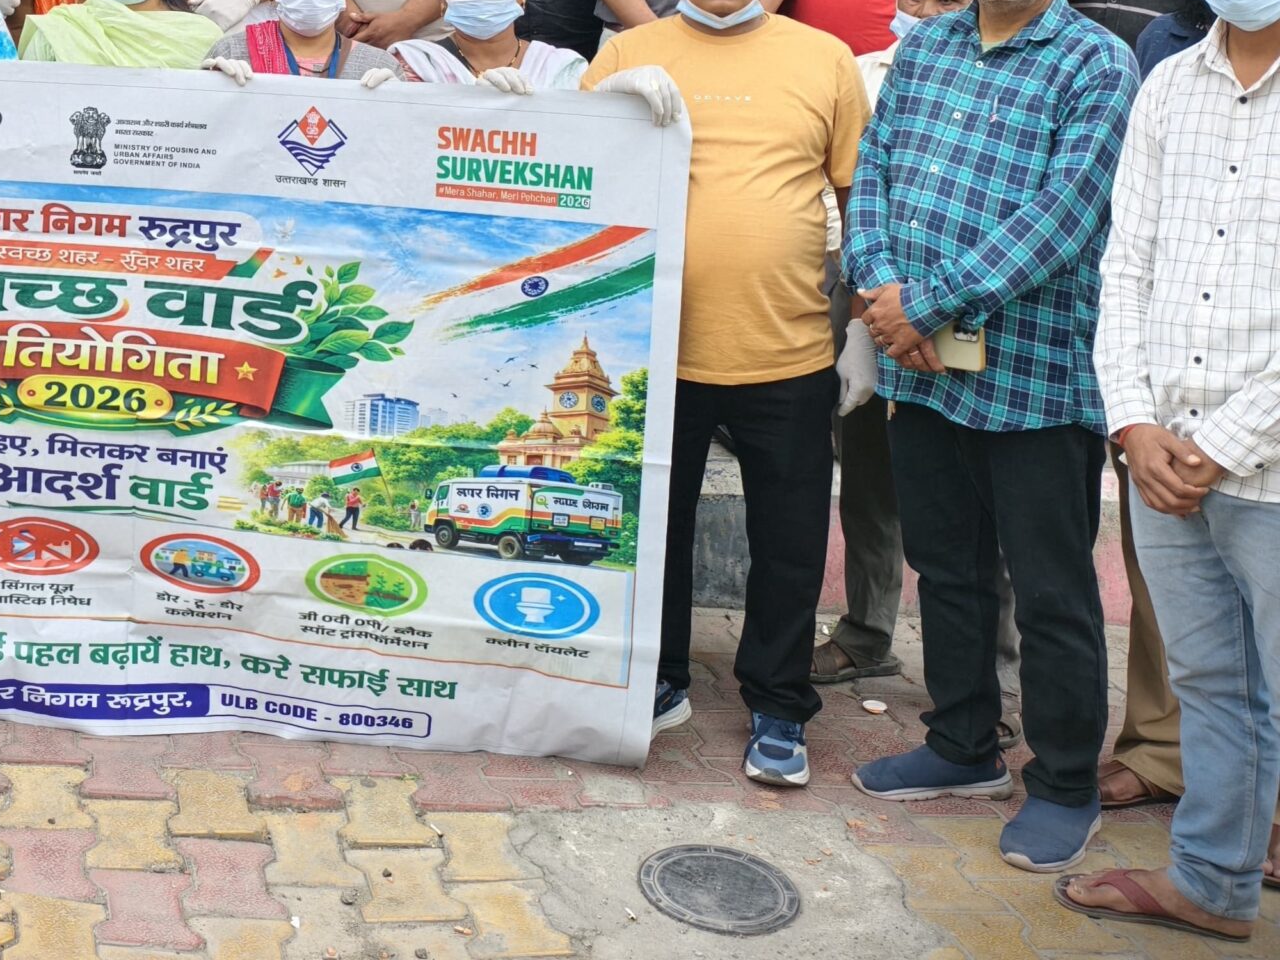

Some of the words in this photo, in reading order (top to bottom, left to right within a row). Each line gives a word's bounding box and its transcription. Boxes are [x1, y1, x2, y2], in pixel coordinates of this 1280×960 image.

[165, 146, 199, 154] HOUSING
[201, 147, 217, 155] AND
[437, 126, 537, 157] SWACHH
[113, 159, 166, 167] GOVERNMENT
[179, 161, 201, 169] INDIA
[142, 152, 173, 160] AFFAIRS
[436, 155, 593, 191] SURVEKSHAN
[439, 185, 465, 196] #Mera
[40, 203, 131, 237] निगम
[139, 216, 241, 251] रुद्रपुर
[60, 249, 99, 266] शहर
[165, 256, 206, 273] शहर
[144, 280, 318, 340] वार्ड
[43, 380, 147, 414] 2026
[46, 433, 149, 463] मिलकर
[156, 446, 228, 474] बनाएं
[129, 472, 213, 511] वार्ड
[0, 579, 45, 592] सिंगल
[50, 593, 91, 607] निषेध
[156, 590, 180, 603] डोर
[219, 600, 244, 611] डोर
[164, 607, 233, 620] कलेक्शन
[299, 611, 318, 621] जी
[486, 636, 530, 650] क्लीन
[534, 641, 590, 659] टॉयलेट
[13, 642, 82, 667] पहल
[170, 642, 231, 670] हाथ,
[239, 655, 292, 679] करे
[299, 664, 390, 697] सफाई
[396, 677, 458, 700] साथ
[22, 685, 100, 708] निगम
[221, 693, 258, 711] ULB
[265, 700, 317, 722] CODE
[338, 713, 414, 730] 800346
